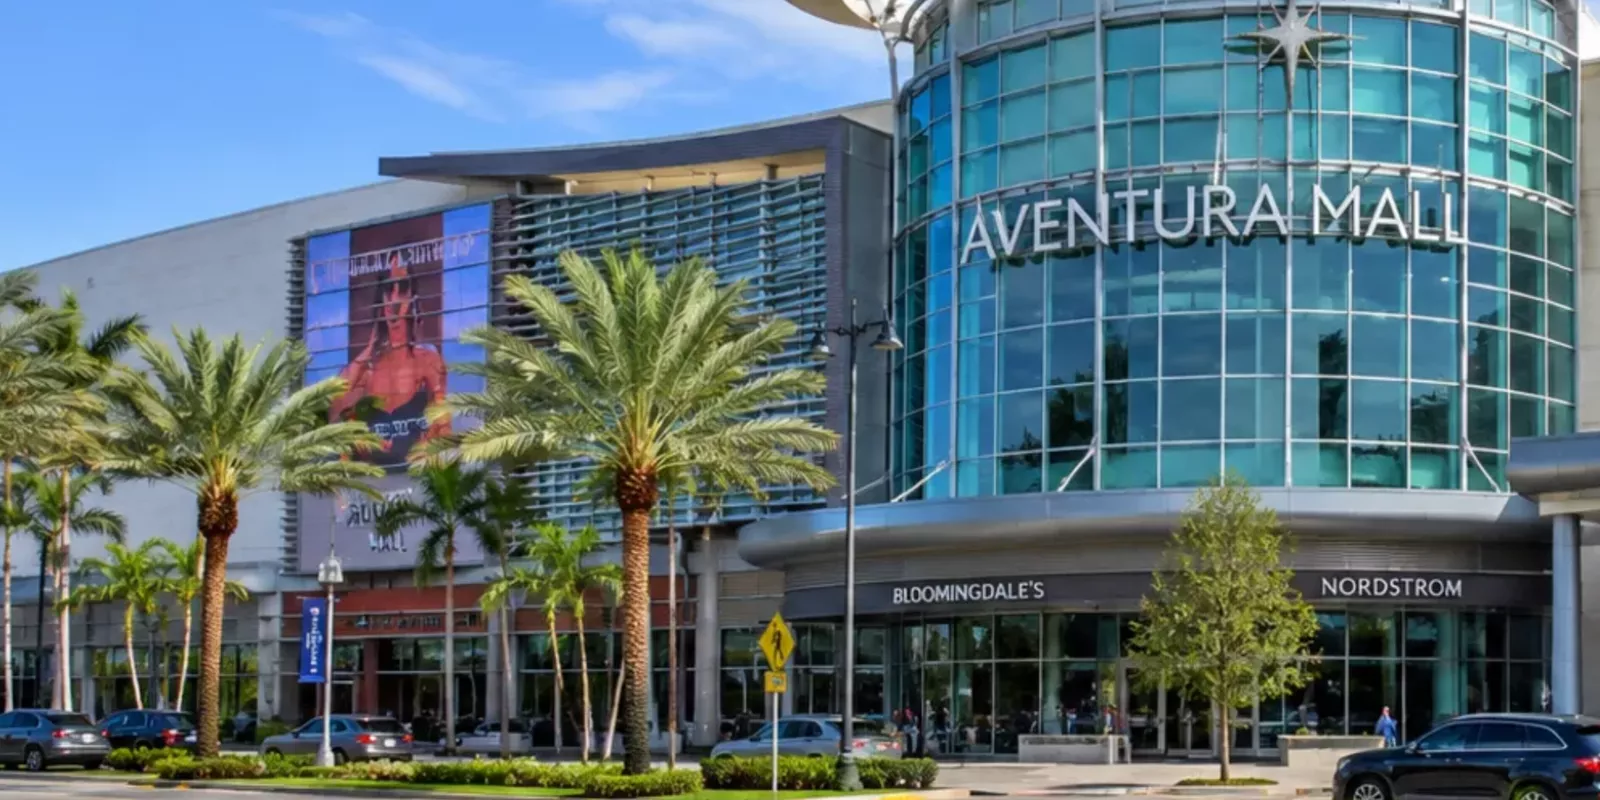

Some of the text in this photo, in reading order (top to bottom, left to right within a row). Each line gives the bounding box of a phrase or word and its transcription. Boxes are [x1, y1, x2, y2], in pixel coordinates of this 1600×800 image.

[961, 184, 1467, 264] AVENTURA MALL
[893, 580, 1044, 604] BLOOMINGDALE'S
[1322, 577, 1462, 597] NORDSTROM
